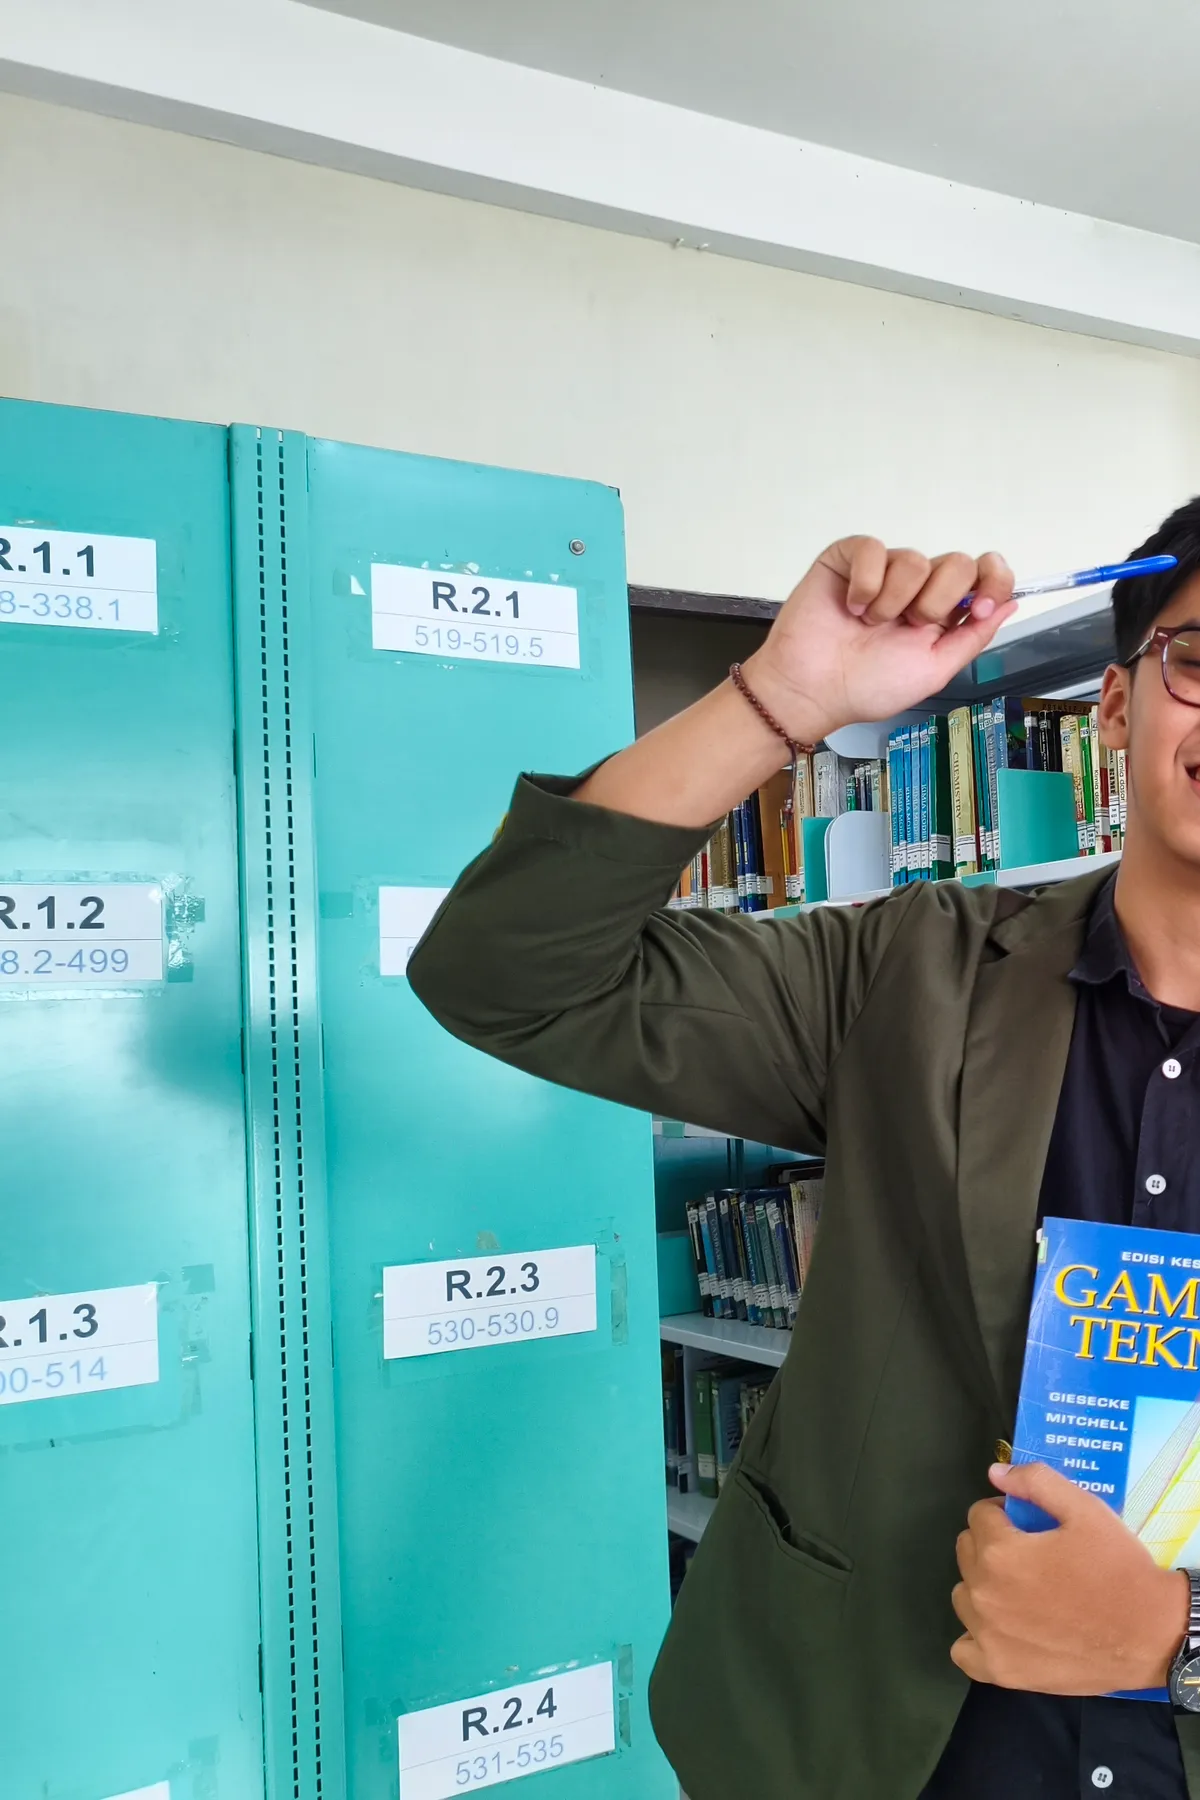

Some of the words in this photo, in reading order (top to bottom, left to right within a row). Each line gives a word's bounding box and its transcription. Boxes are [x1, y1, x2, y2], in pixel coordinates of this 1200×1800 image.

[432, 581, 520, 618] R.2.1
[415, 624, 543, 659] 519-519.5
[912, 785, 920, 808] KIMIA
[953, 751, 962, 820] CHEMISTRY
[0, 896, 105, 930] R.1.2
[0, 948, 129, 975] 8.2-499
[1121, 1251, 1164, 1265] EDISI
[446, 1262, 540, 1301] R.2.3
[428, 1307, 559, 1345] 530-530.9
[1049, 1391, 1130, 1410] GIESECKE
[1046, 1412, 1128, 1431] MITCHELL
[1045, 1433, 1124, 1451] SPENCER
[1063, 1457, 1100, 1471] HILL
[462, 1687, 557, 1742] R.2.4
[456, 1734, 564, 1785] 531-535
